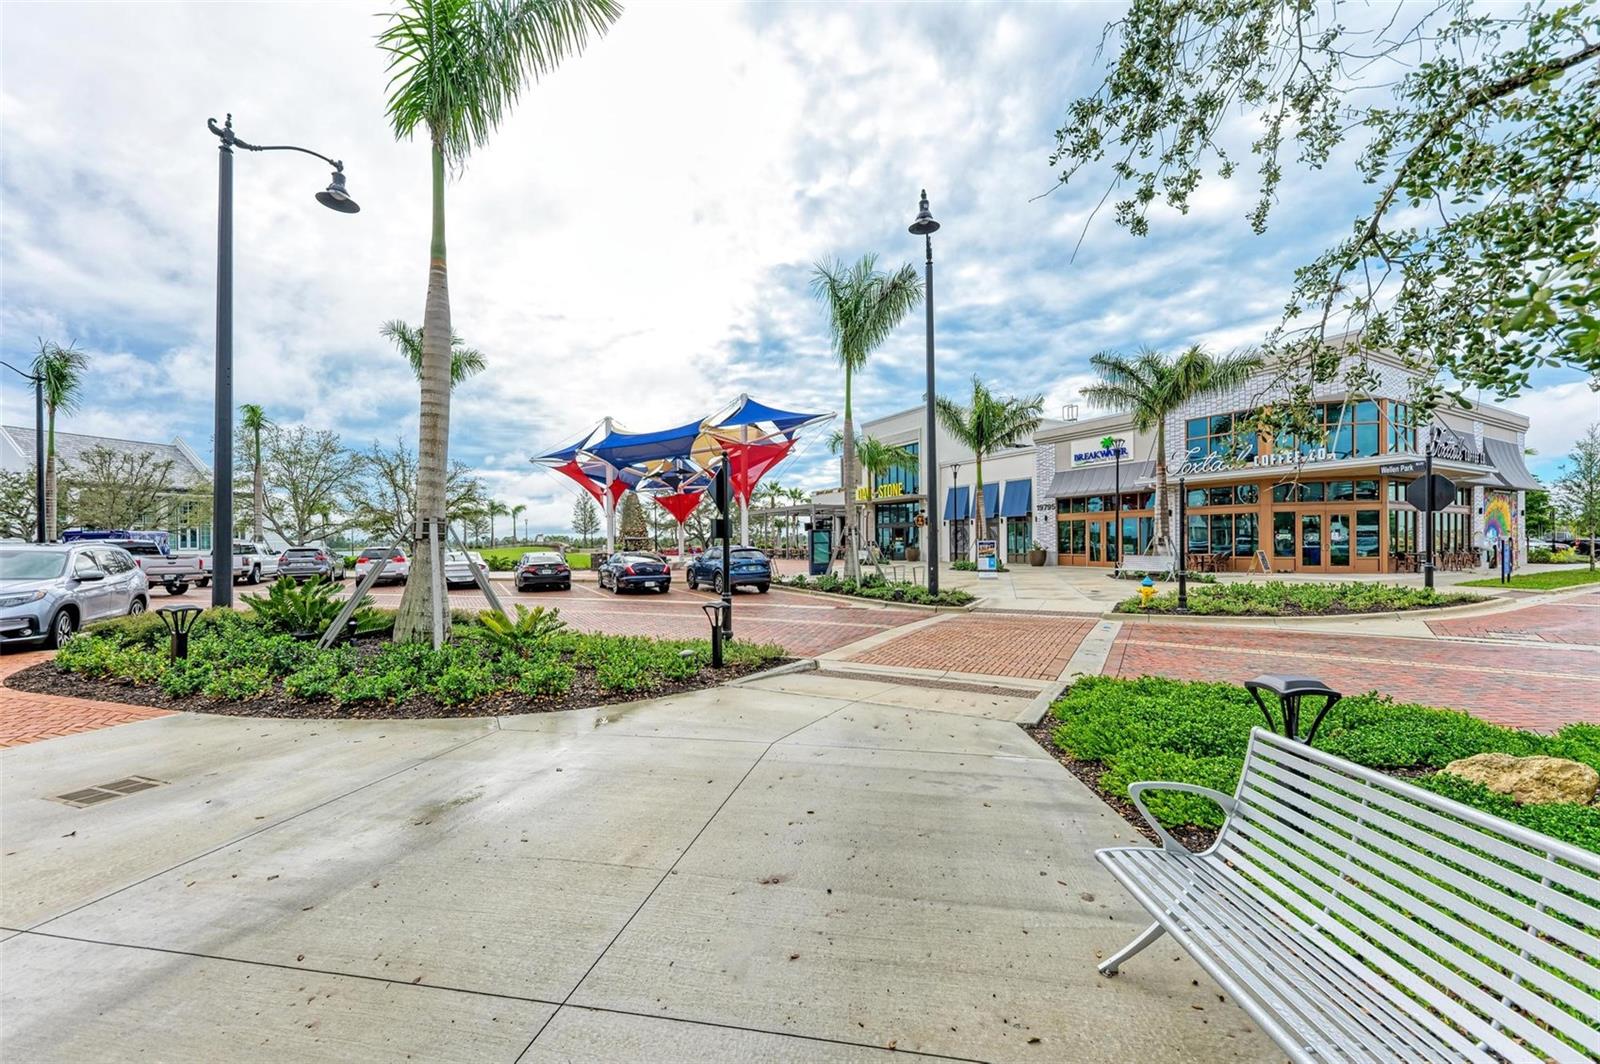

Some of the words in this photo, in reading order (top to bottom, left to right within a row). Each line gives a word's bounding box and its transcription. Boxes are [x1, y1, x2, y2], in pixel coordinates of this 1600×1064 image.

[1073, 447, 1128, 461] BREAKWATR
[1253, 451, 1301, 467] COFFEE
[1380, 465, 1400, 474] Wellen
[1400, 464, 1414, 472] Park
[855, 485, 873, 501] OA
[878, 482, 904, 499] STONE
[1036, 503, 1056, 511] 19795
